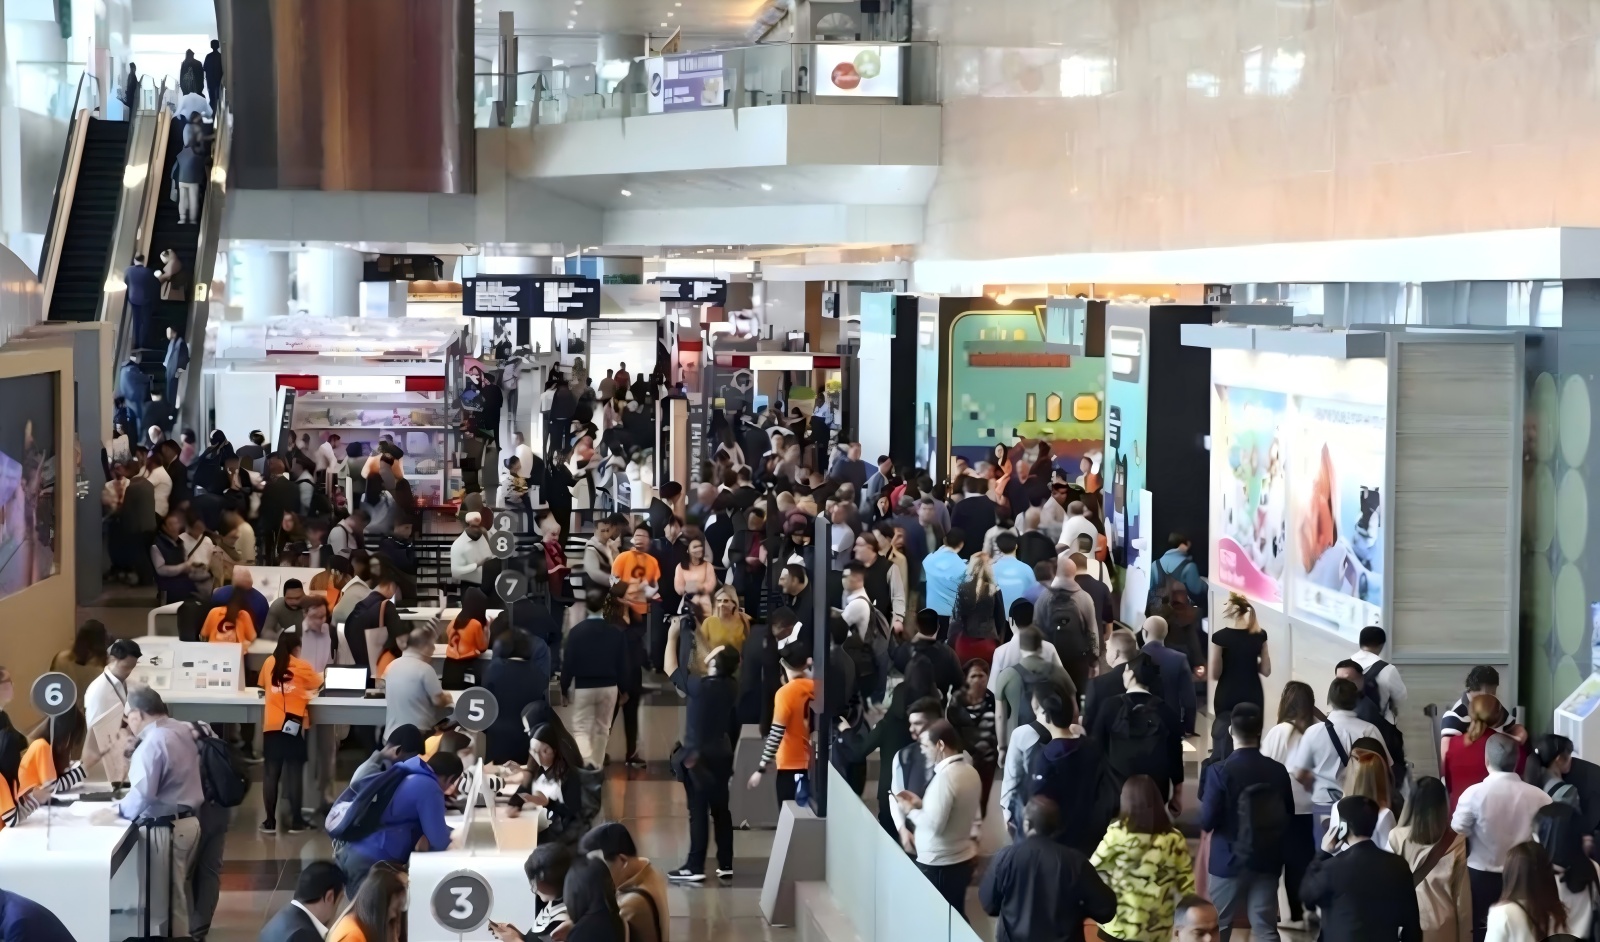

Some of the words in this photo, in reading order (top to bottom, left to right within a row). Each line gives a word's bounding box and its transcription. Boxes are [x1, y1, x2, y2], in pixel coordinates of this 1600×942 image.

[499, 516, 511, 532] 9
[496, 537, 509, 552] 8
[505, 578, 519, 596] 7
[44, 682, 64, 706] 6
[467, 698, 485, 722] 5
[449, 886, 475, 920] 3
